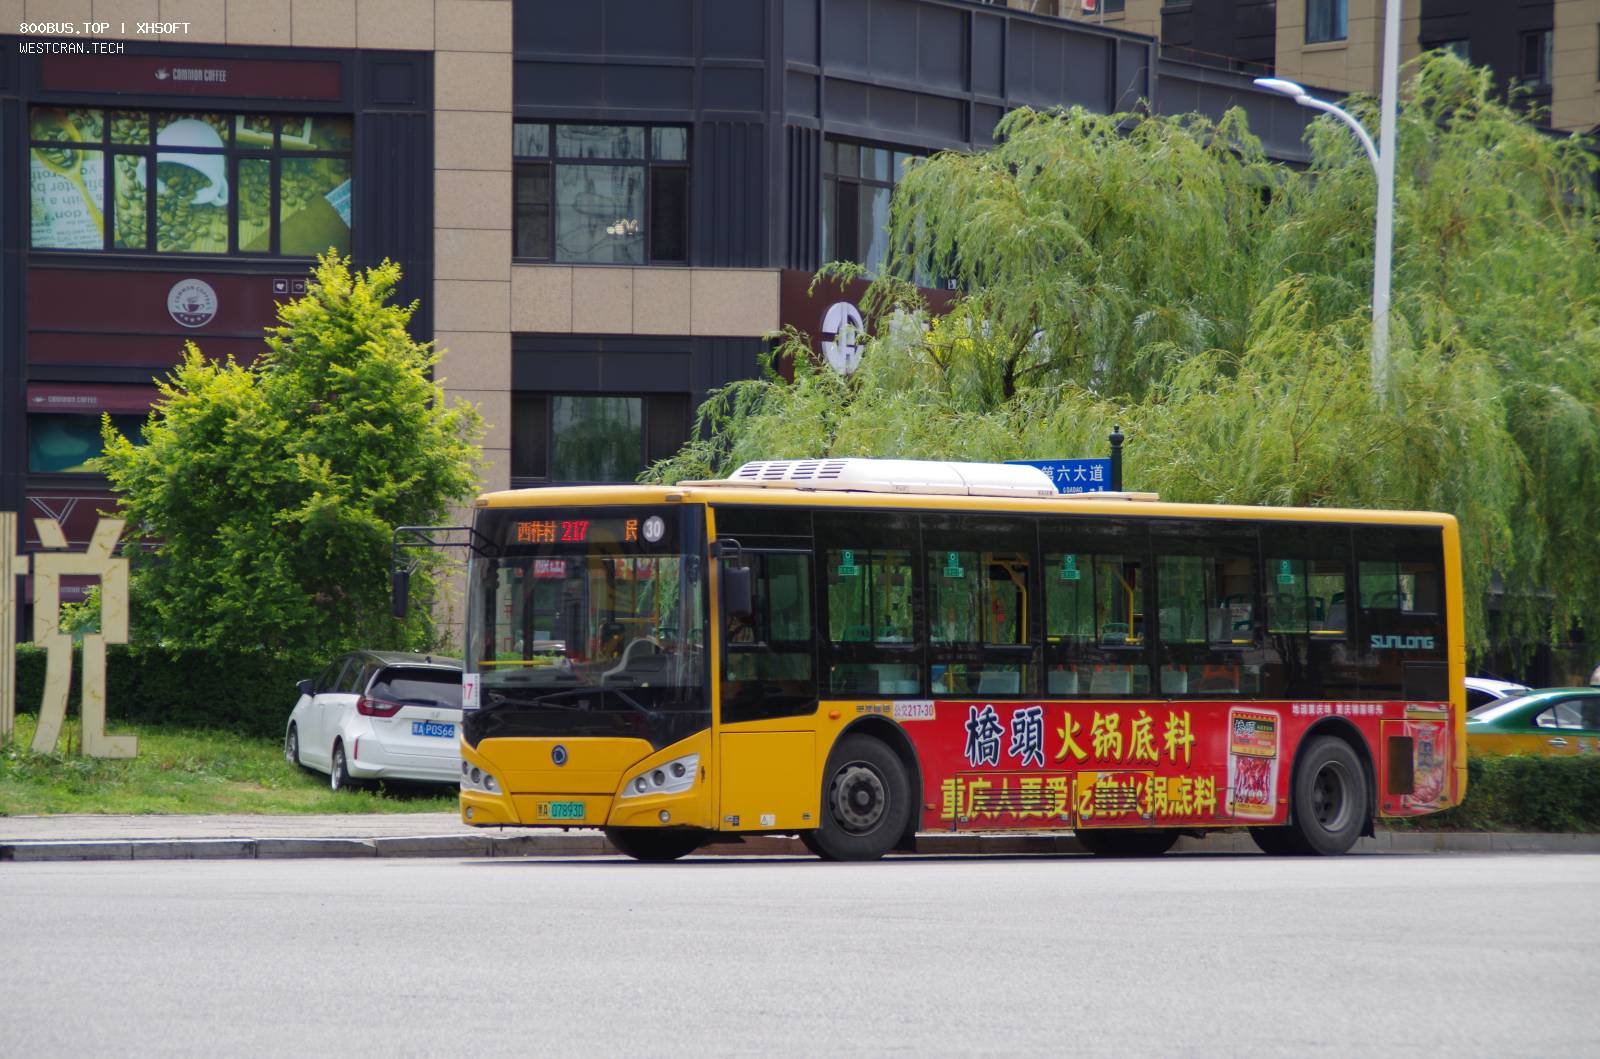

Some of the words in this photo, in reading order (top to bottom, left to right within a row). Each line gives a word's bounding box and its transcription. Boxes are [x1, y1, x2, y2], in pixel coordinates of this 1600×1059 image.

[204, 69, 227, 82] COFFEE
[560, 520, 589, 542] 217
[624, 519, 638, 542] 民
[646, 520, 662, 538] 30
[1370, 635, 1434, 650] SUNLONG
[964, 704, 1047, 768] 橋頭
[1054, 710, 1196, 767] 火锅底料
